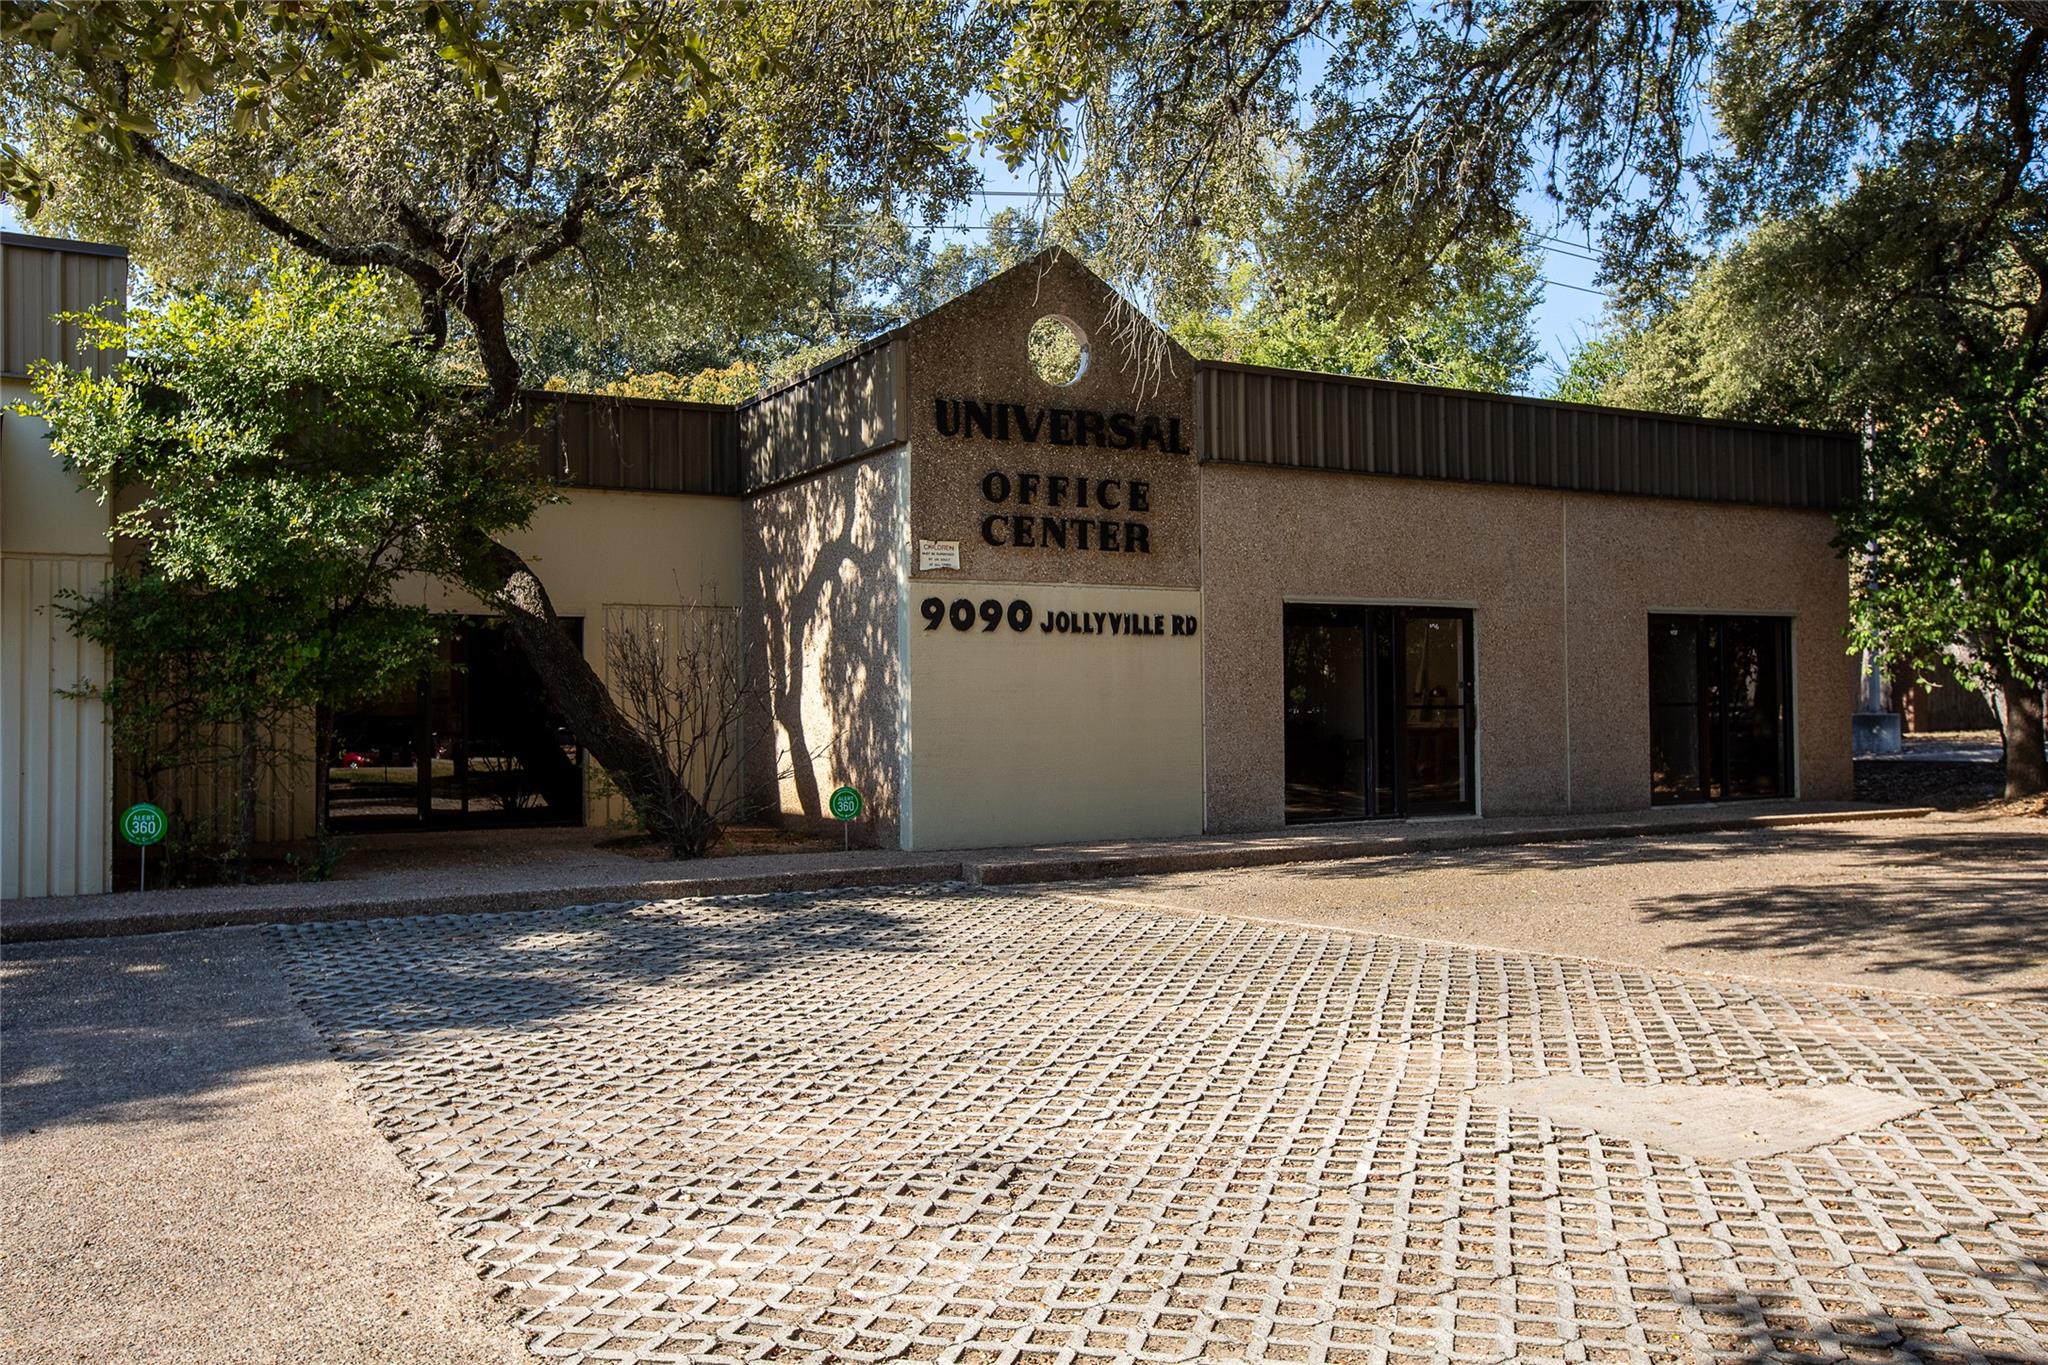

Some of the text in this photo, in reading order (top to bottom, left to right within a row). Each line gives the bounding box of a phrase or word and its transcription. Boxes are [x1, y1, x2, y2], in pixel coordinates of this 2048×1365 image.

[934, 399, 1190, 455] UNIVERSAL
[981, 471, 1149, 512] OFFICE
[981, 515, 1150, 553] CENTER
[920, 597, 1198, 636] 9090 JOLLYVILLE RD
[837, 801, 854, 811] 360
[132, 821, 155, 833] 360
